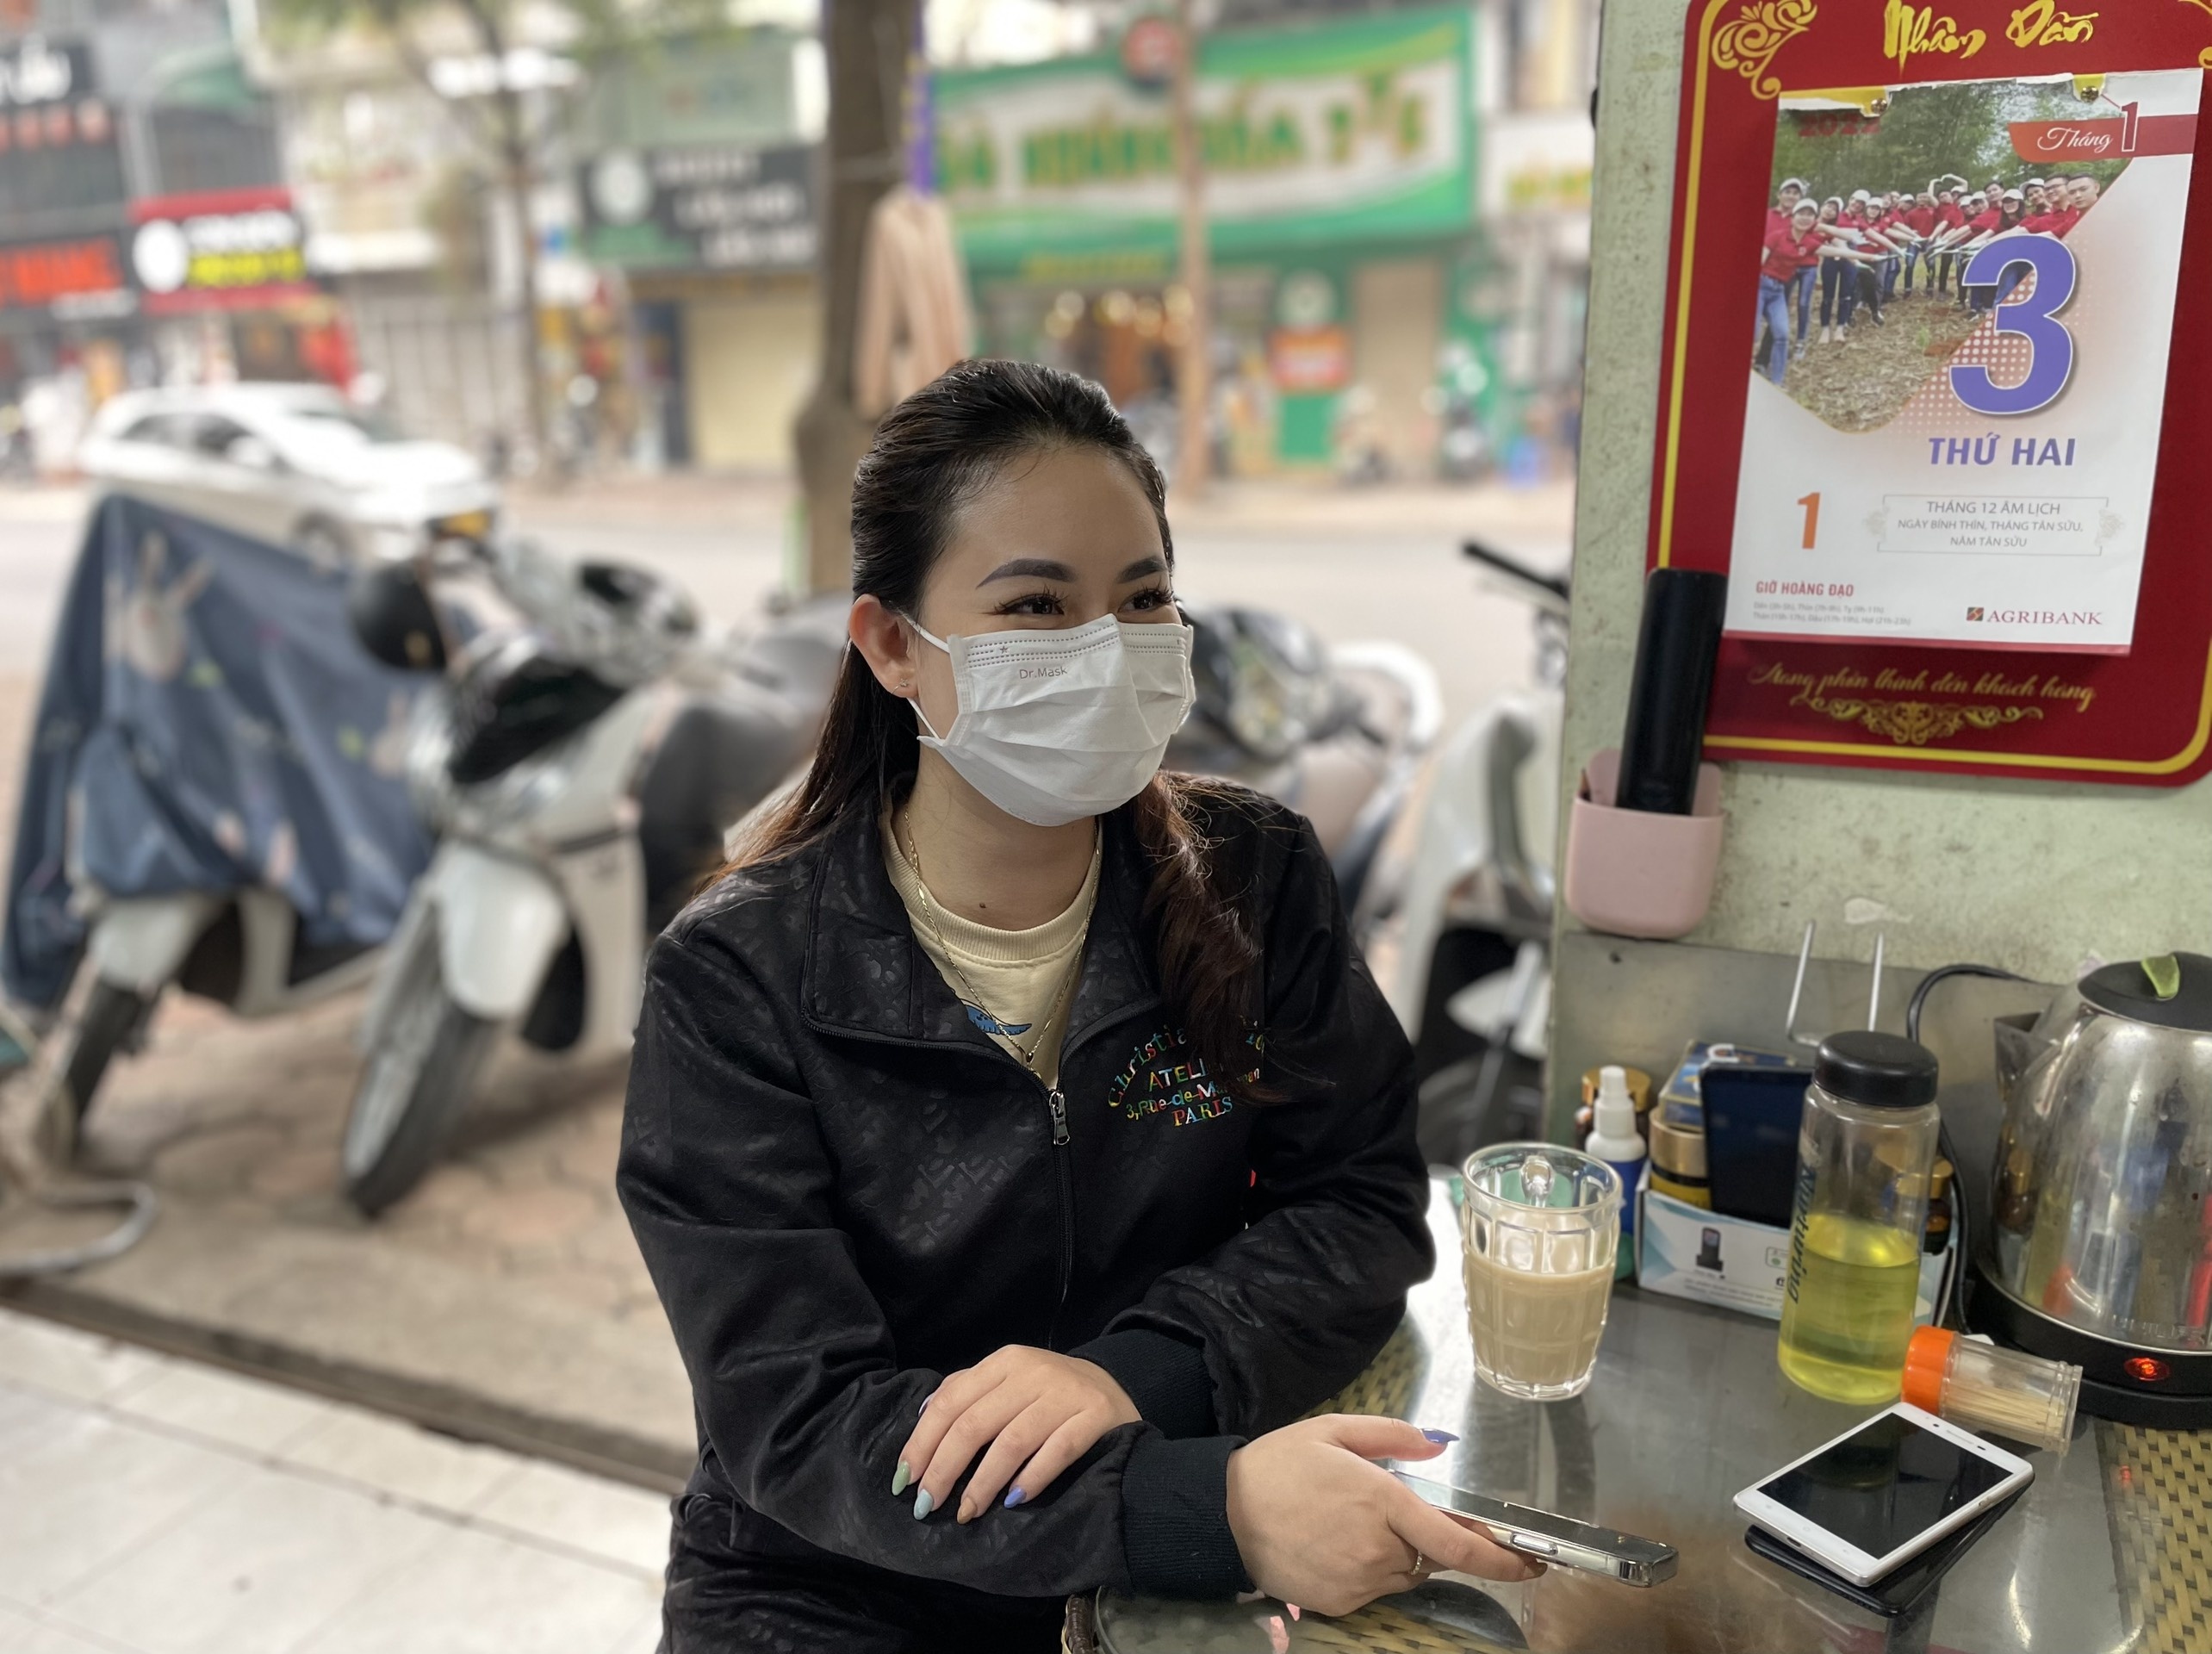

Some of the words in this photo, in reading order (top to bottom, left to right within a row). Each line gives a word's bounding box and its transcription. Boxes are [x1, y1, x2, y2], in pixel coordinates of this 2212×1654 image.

[2037, 127, 2113, 153] Tháng
[2121, 101, 2138, 152] 1
[1950, 235, 2076, 414] 3
[1929, 432, 2001, 465] THỨ
[2011, 438, 2076, 466] HAI
[1927, 499, 1977, 514] THÁNG
[1982, 502, 1998, 514] 12
[2000, 501, 2024, 514] ÂM
[2028, 503, 2060, 518] LỊCH
[1797, 492, 1821, 550] 1
[1898, 519, 1929, 529] NGÀY
[1991, 519, 2029, 531] THÁNG
[2033, 519, 2054, 531] TÂN
[1950, 536, 1976, 546] NĂM
[1980, 536, 2001, 546] TÂN
[1756, 580, 1777, 594] GIỜ
[1781, 581, 1824, 596] HOÀNG
[1829, 584, 1855, 599] ĐẠO
[1987, 610, 2103, 625] AGRIBANK
[1019, 666, 1068, 680] Dr.Mask
[1171, 1097, 1233, 1127] PARIS
